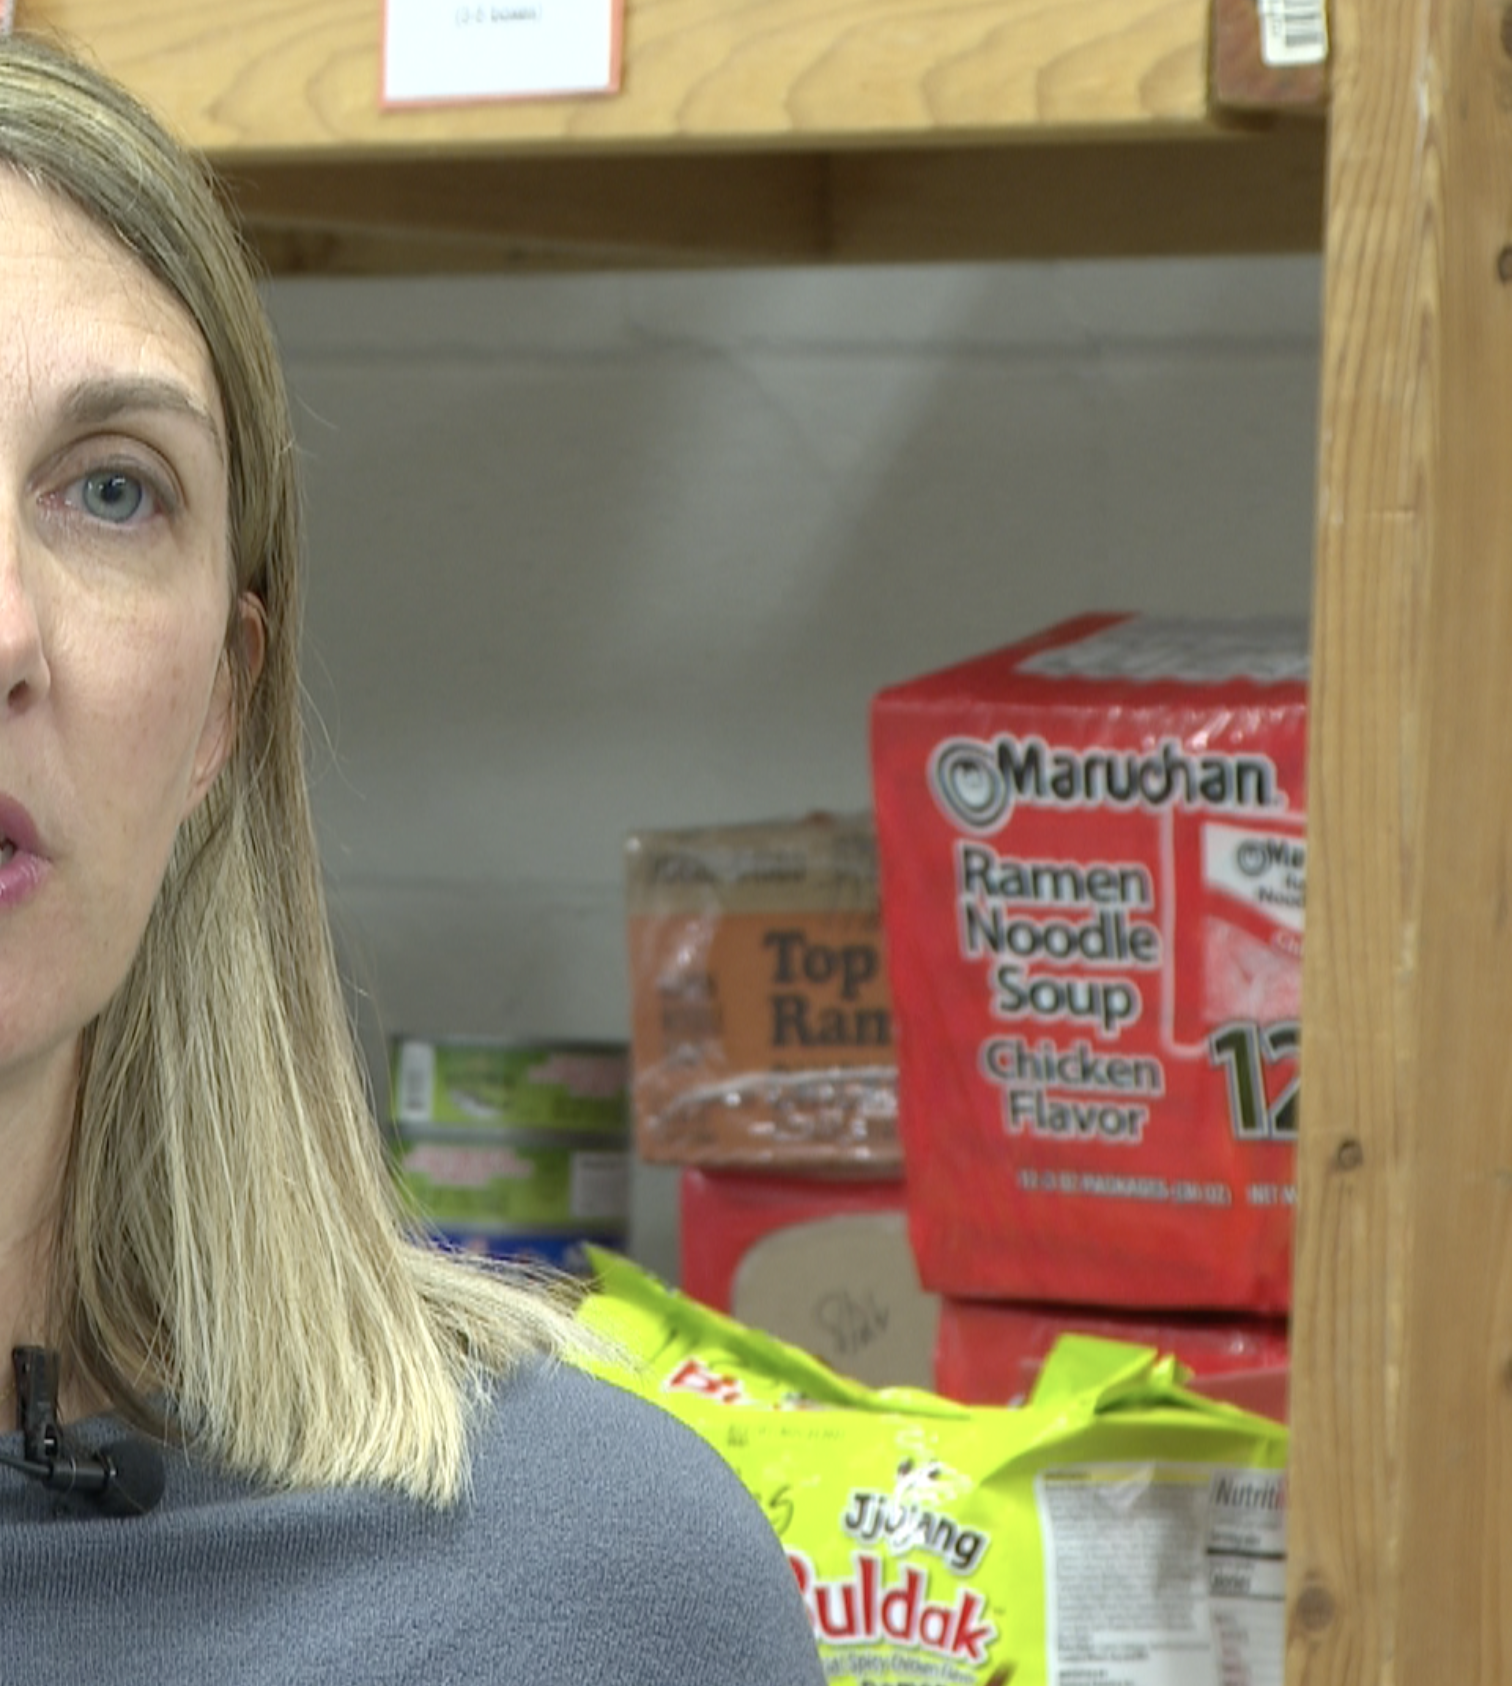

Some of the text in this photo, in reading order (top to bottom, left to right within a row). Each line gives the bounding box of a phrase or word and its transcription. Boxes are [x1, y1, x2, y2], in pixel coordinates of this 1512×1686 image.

[994, 735, 1274, 809] Maruchan
[958, 841, 1152, 906] Ramen
[763, 927, 878, 1001] Top
[962, 904, 1159, 963] Noodle
[996, 962, 1136, 1034] Soup
[982, 1038, 1163, 1092] Chicken
[1007, 1088, 1147, 1137] Flavor
